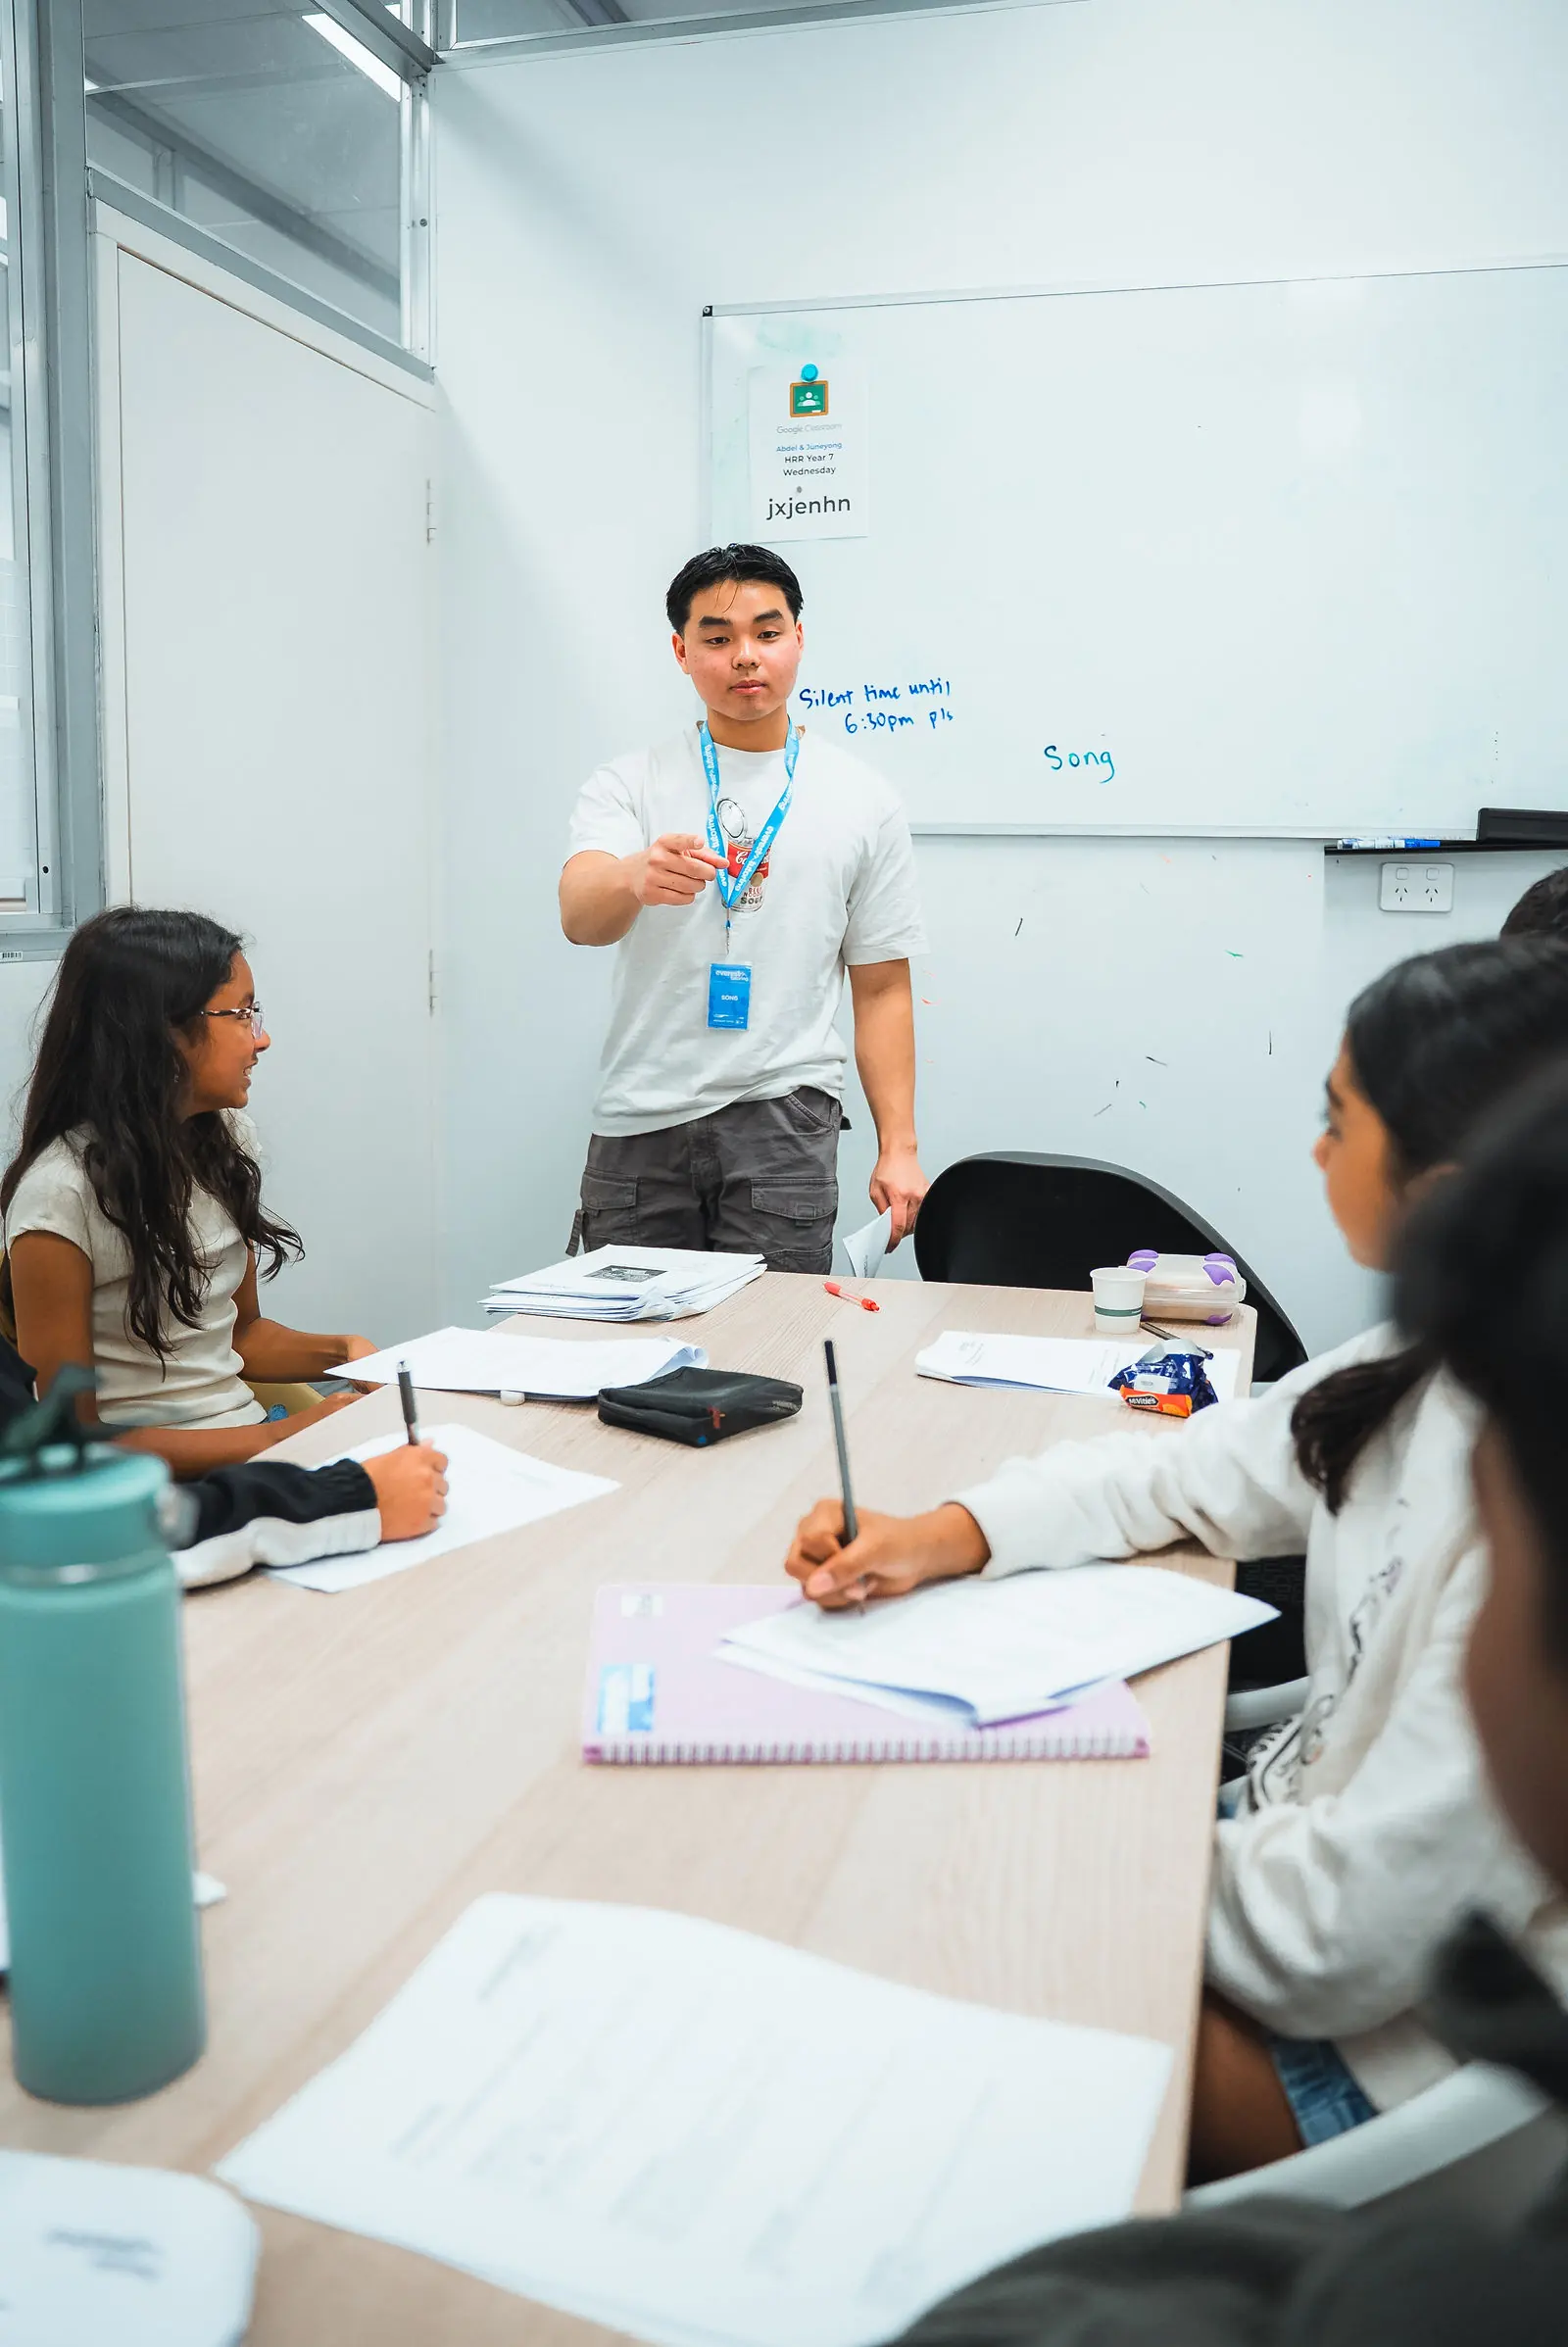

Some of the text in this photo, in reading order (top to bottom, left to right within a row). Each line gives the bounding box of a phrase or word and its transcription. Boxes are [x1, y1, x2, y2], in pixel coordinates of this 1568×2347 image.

[775, 422, 843, 435] Google Classroom
[784, 455, 805, 464] HRR
[807, 453, 827, 463] Year
[807, 441, 843, 451] Juneyong
[783, 465, 837, 476] Wednesday
[766, 495, 852, 520] jxjenhn
[799, 677, 952, 709] Silent time until
[844, 708, 955, 735] 6:30pm pls
[1043, 744, 1115, 783] Song
[708, 813, 720, 849] tutoring
[754, 825, 774, 856] everest
[734, 858, 758, 892] tutoring
